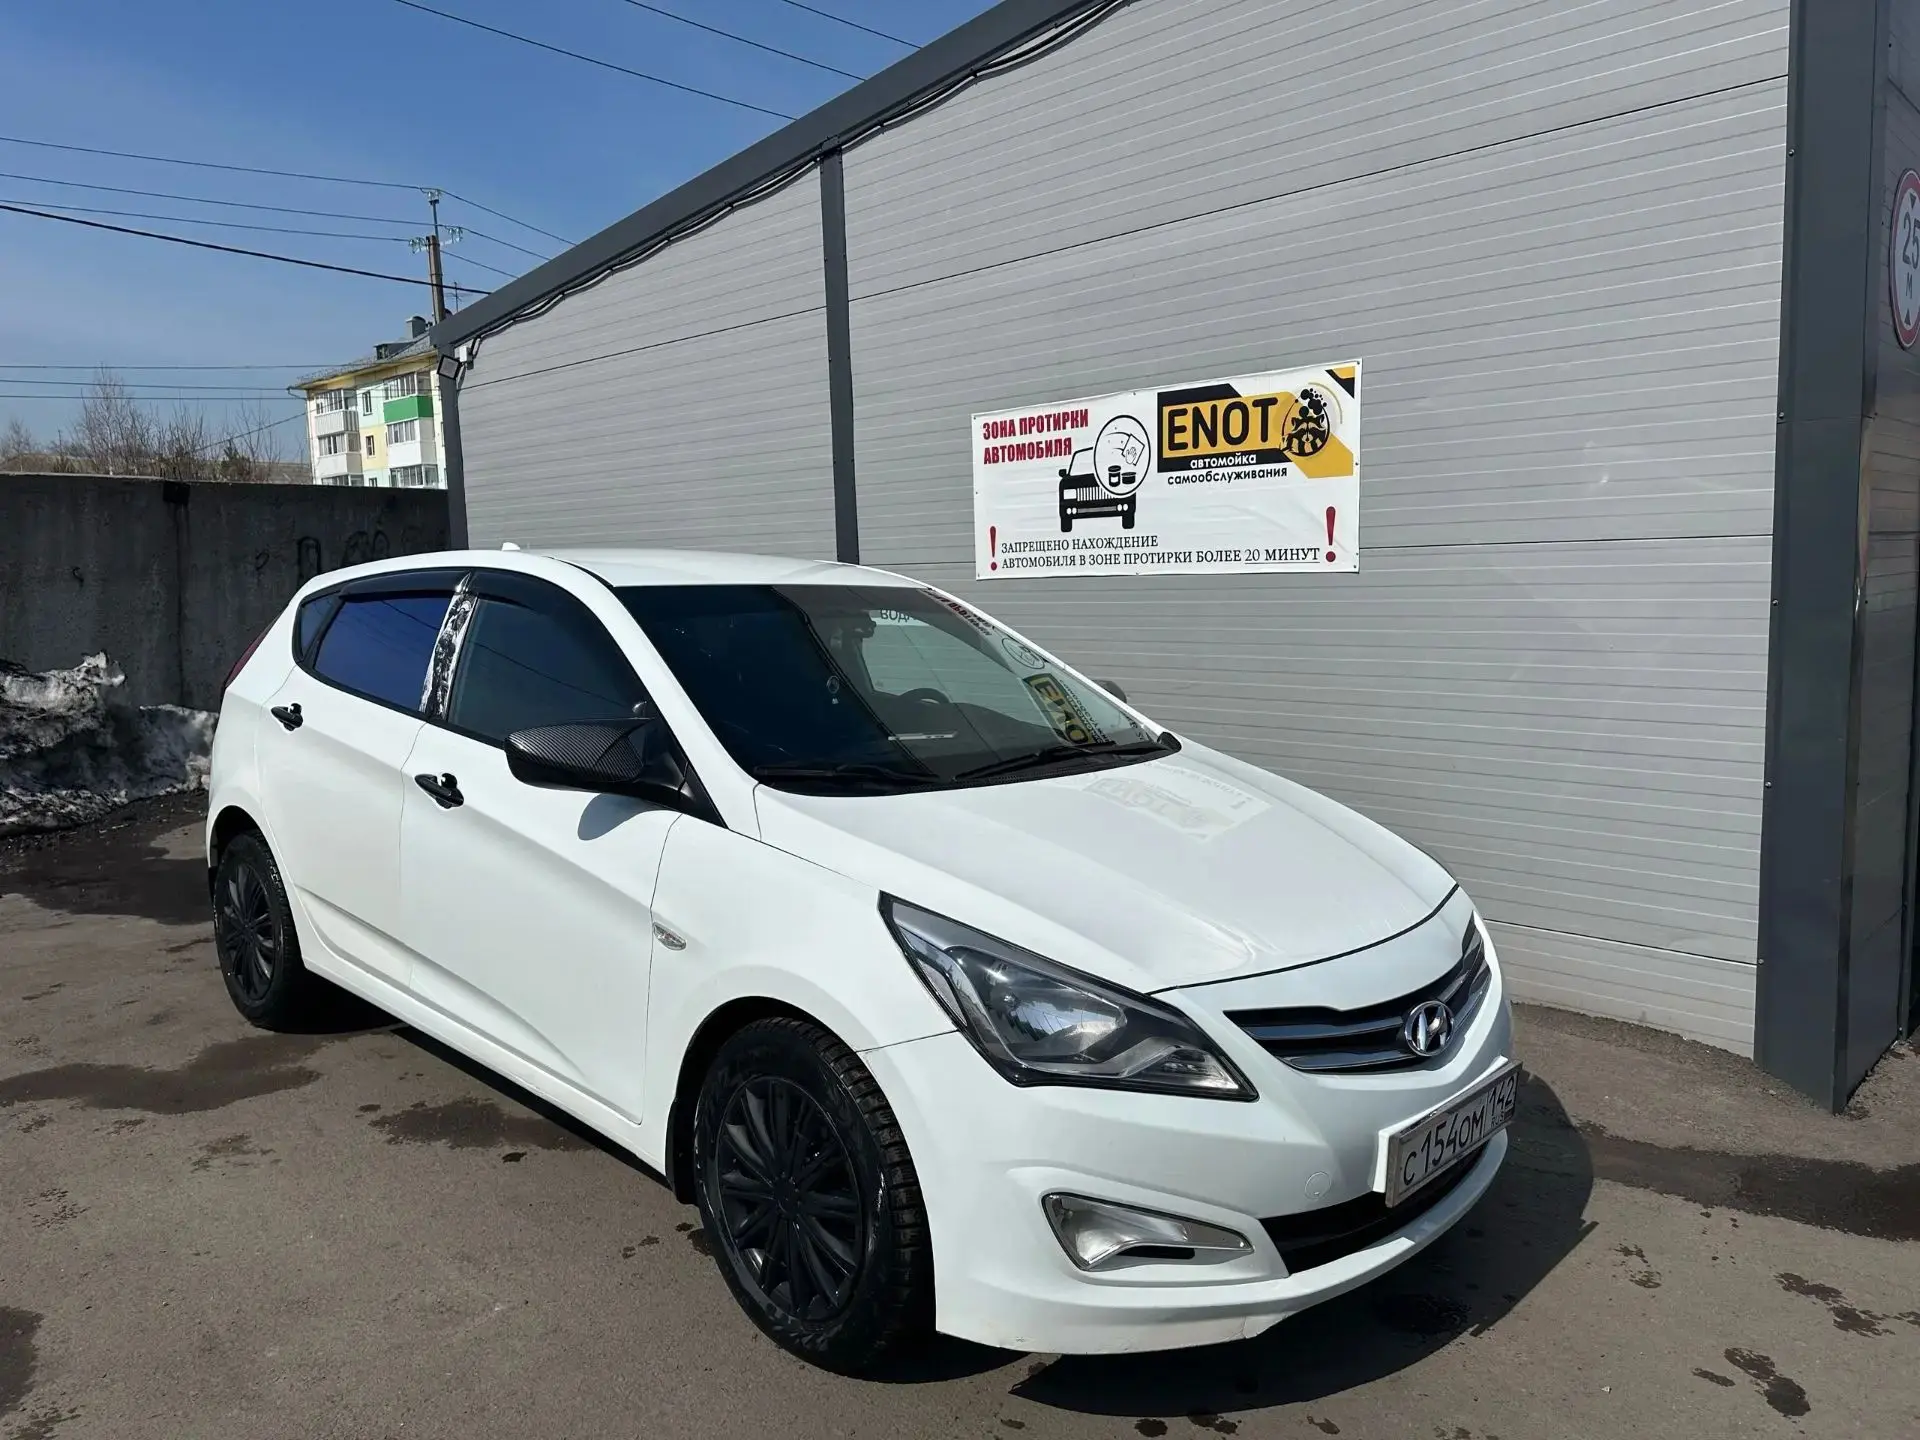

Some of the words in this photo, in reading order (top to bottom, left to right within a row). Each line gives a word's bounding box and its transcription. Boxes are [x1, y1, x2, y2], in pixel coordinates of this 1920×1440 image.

[983, 419, 1016, 440] ЗОНА
[1019, 409, 1089, 436] ПРОТИРКИ
[1167, 397, 1278, 451] ENOT
[983, 437, 1072, 465] АВТОМОБИЛЯ
[1190, 453, 1257, 469] автомойка
[1167, 467, 1288, 485] самообслуживания
[1001, 539, 1070, 554] ЗАПРЕЩЕНО
[1072, 535, 1158, 551] НАХОЖДЕНИЕ
[1002, 555, 1075, 569] АВТОМОБИЛЯ
[1079, 554, 1087, 566] В
[1089, 553, 1121, 566] ЗОНЕ
[1123, 551, 1192, 566] ПРОТИРКИ
[1196, 550, 1242, 563] БОЛЕЕ
[1245, 548, 1260, 562] 20
[1264, 547, 1320, 562] МИНУТ
[880, 608, 910, 623] ВОД
